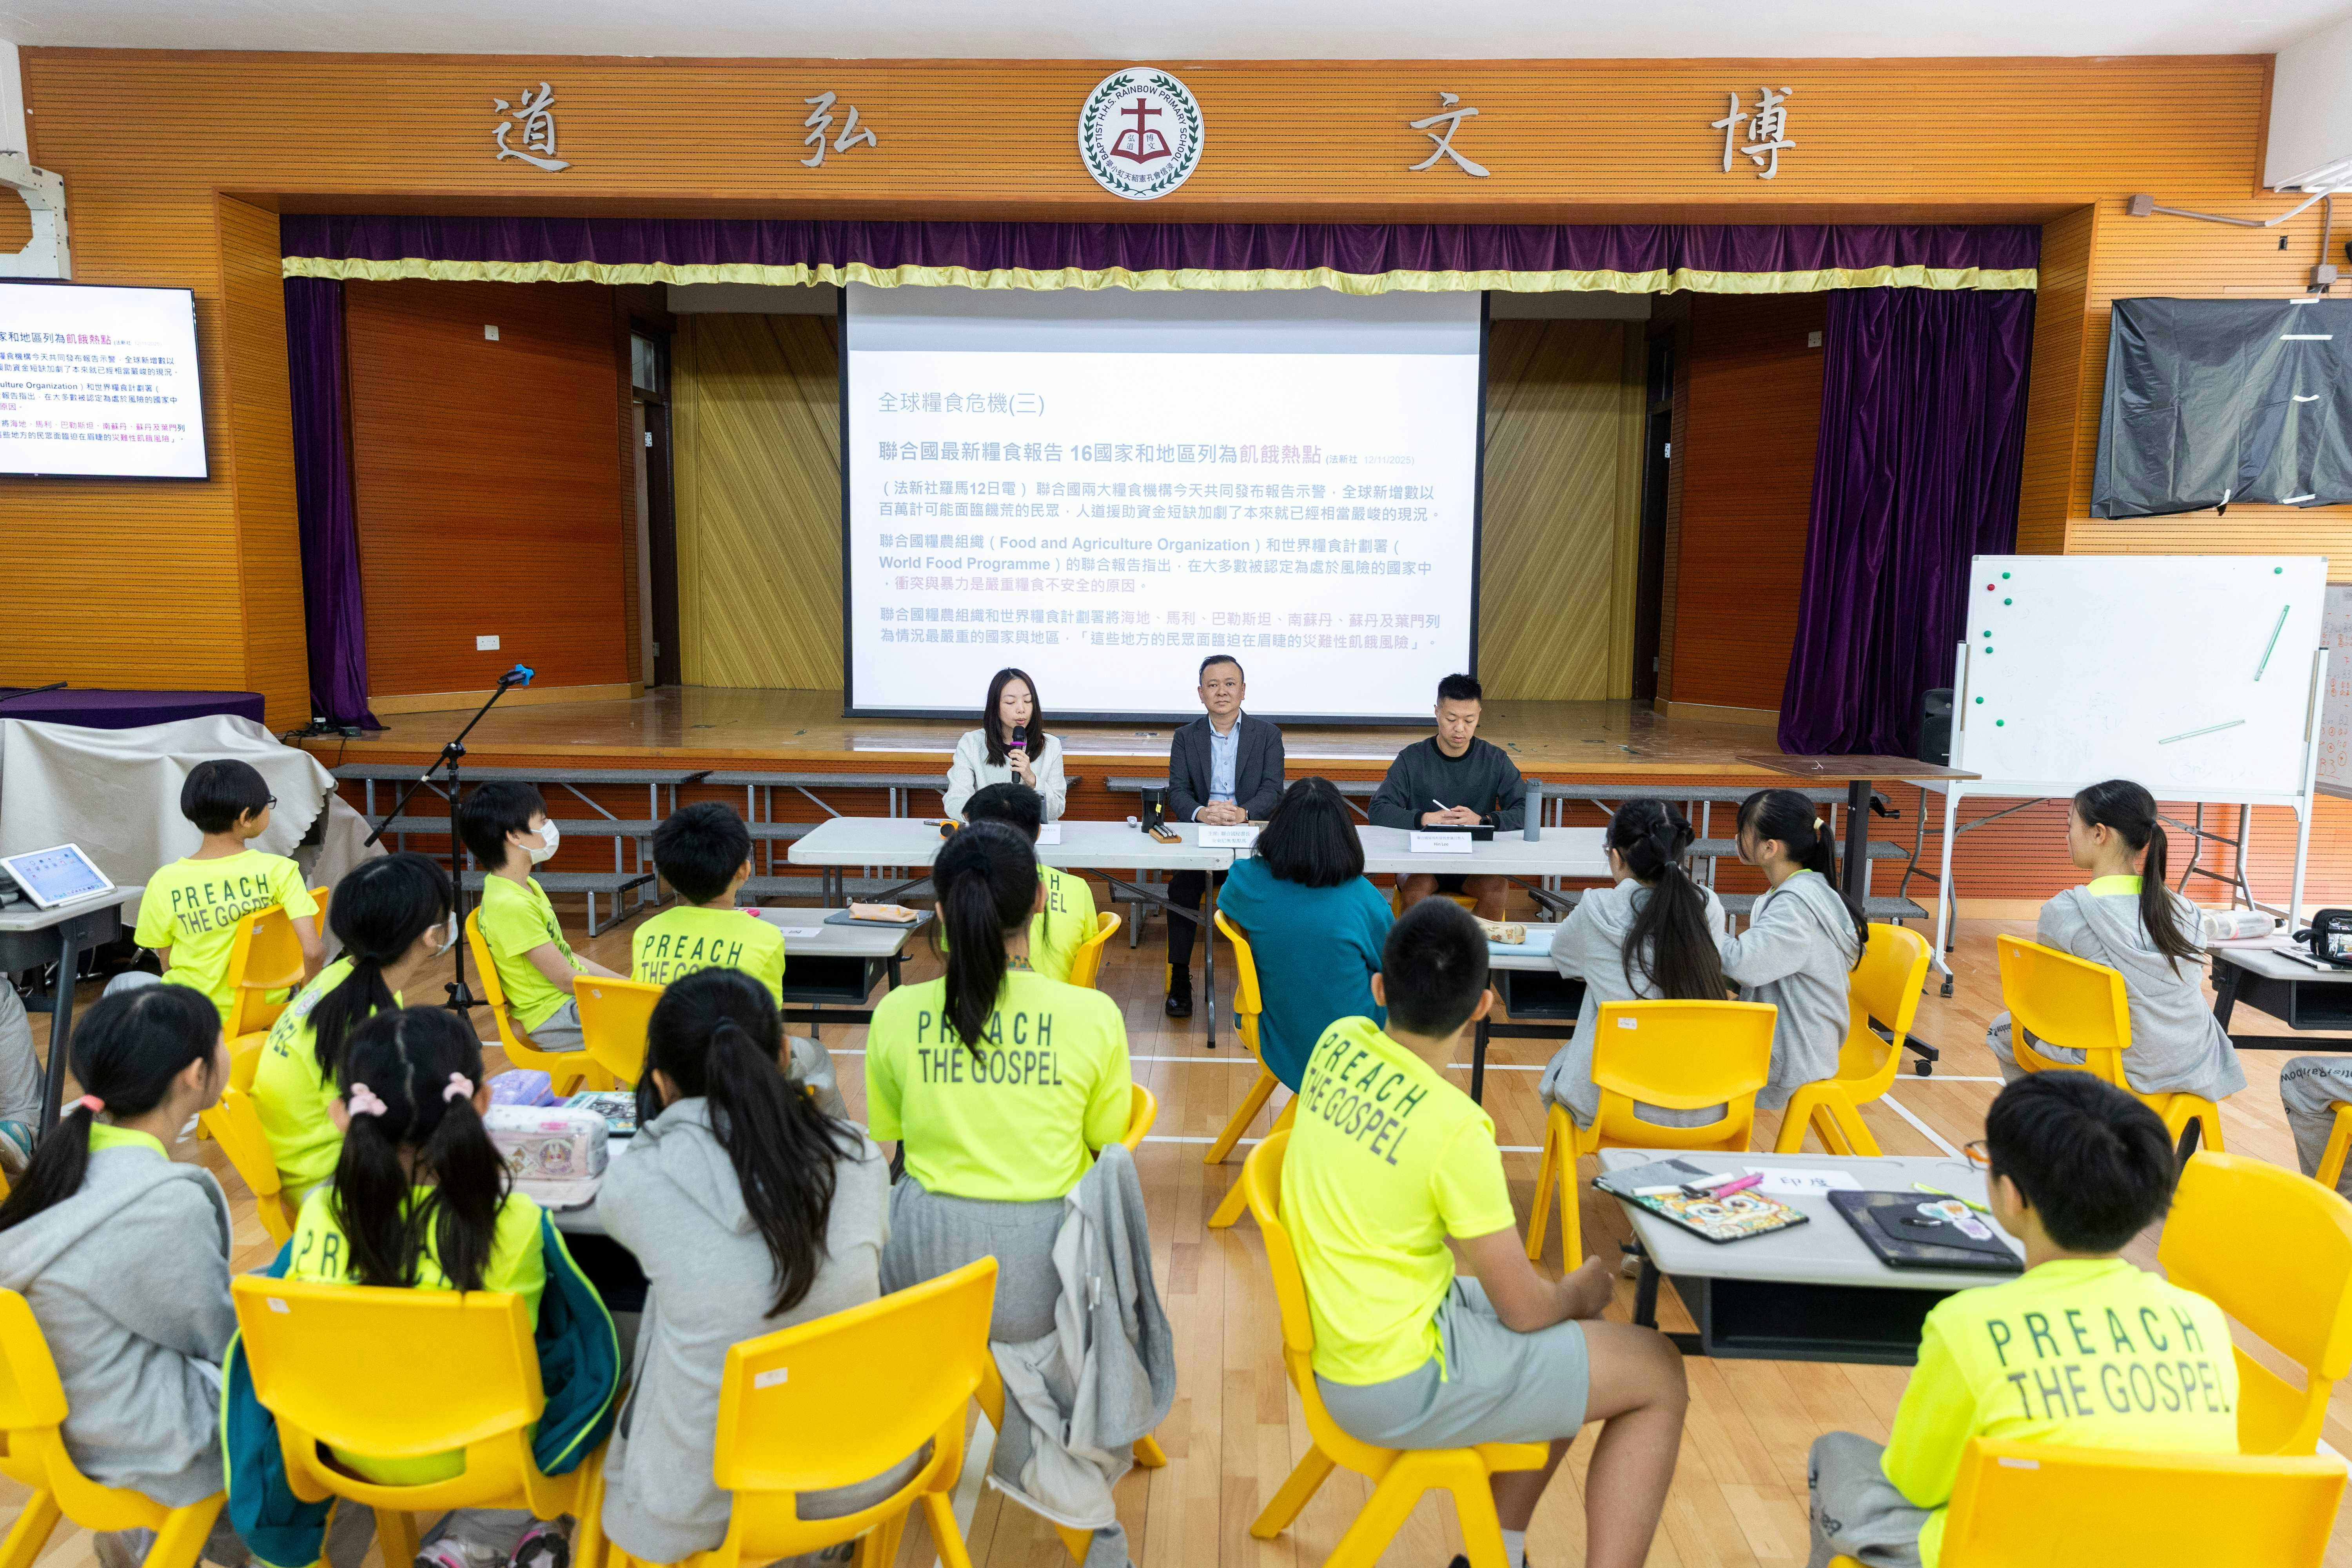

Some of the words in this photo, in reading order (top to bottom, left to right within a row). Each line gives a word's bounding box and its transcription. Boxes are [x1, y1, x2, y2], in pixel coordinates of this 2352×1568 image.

[1098, 98, 1116, 121] H.H.S.
[1115, 85, 1158, 100] RAINBOW
[1158, 90, 1186, 125] PRIMARY
[492, 82, 572, 173] 道
[800, 91, 877, 168] 弘
[1095, 122, 1109, 160] BAPTIST
[1171, 127, 1187, 162] SCHOOL
[1409, 92, 1490, 177] 文
[1711, 86, 1796, 180] 博
[878, 392, 1044, 417] 全球糧食危機(三)
[878, 441, 1063, 462] 聯合國最新糧食報告
[879, 556, 921, 568] World
[926, 557, 962, 569] Food
[1072, 537, 1152, 552] Agriculture
[171, 874, 269, 912] PREACH
[177, 909, 212, 935] THE
[642, 935, 743, 966] PREACH
[641, 961, 670, 985] THE
[918, 1048, 963, 1082] THE
[972, 1049, 1062, 1085] GOSPEL
[1314, 1033, 1428, 1118] PREACH
[1301, 1067, 1332, 1113] THE
[1323, 1087, 1408, 1166] GOSPEL
[1987, 1307, 2204, 1367] PREACH
[2007, 1364, 2094, 1420] THE
